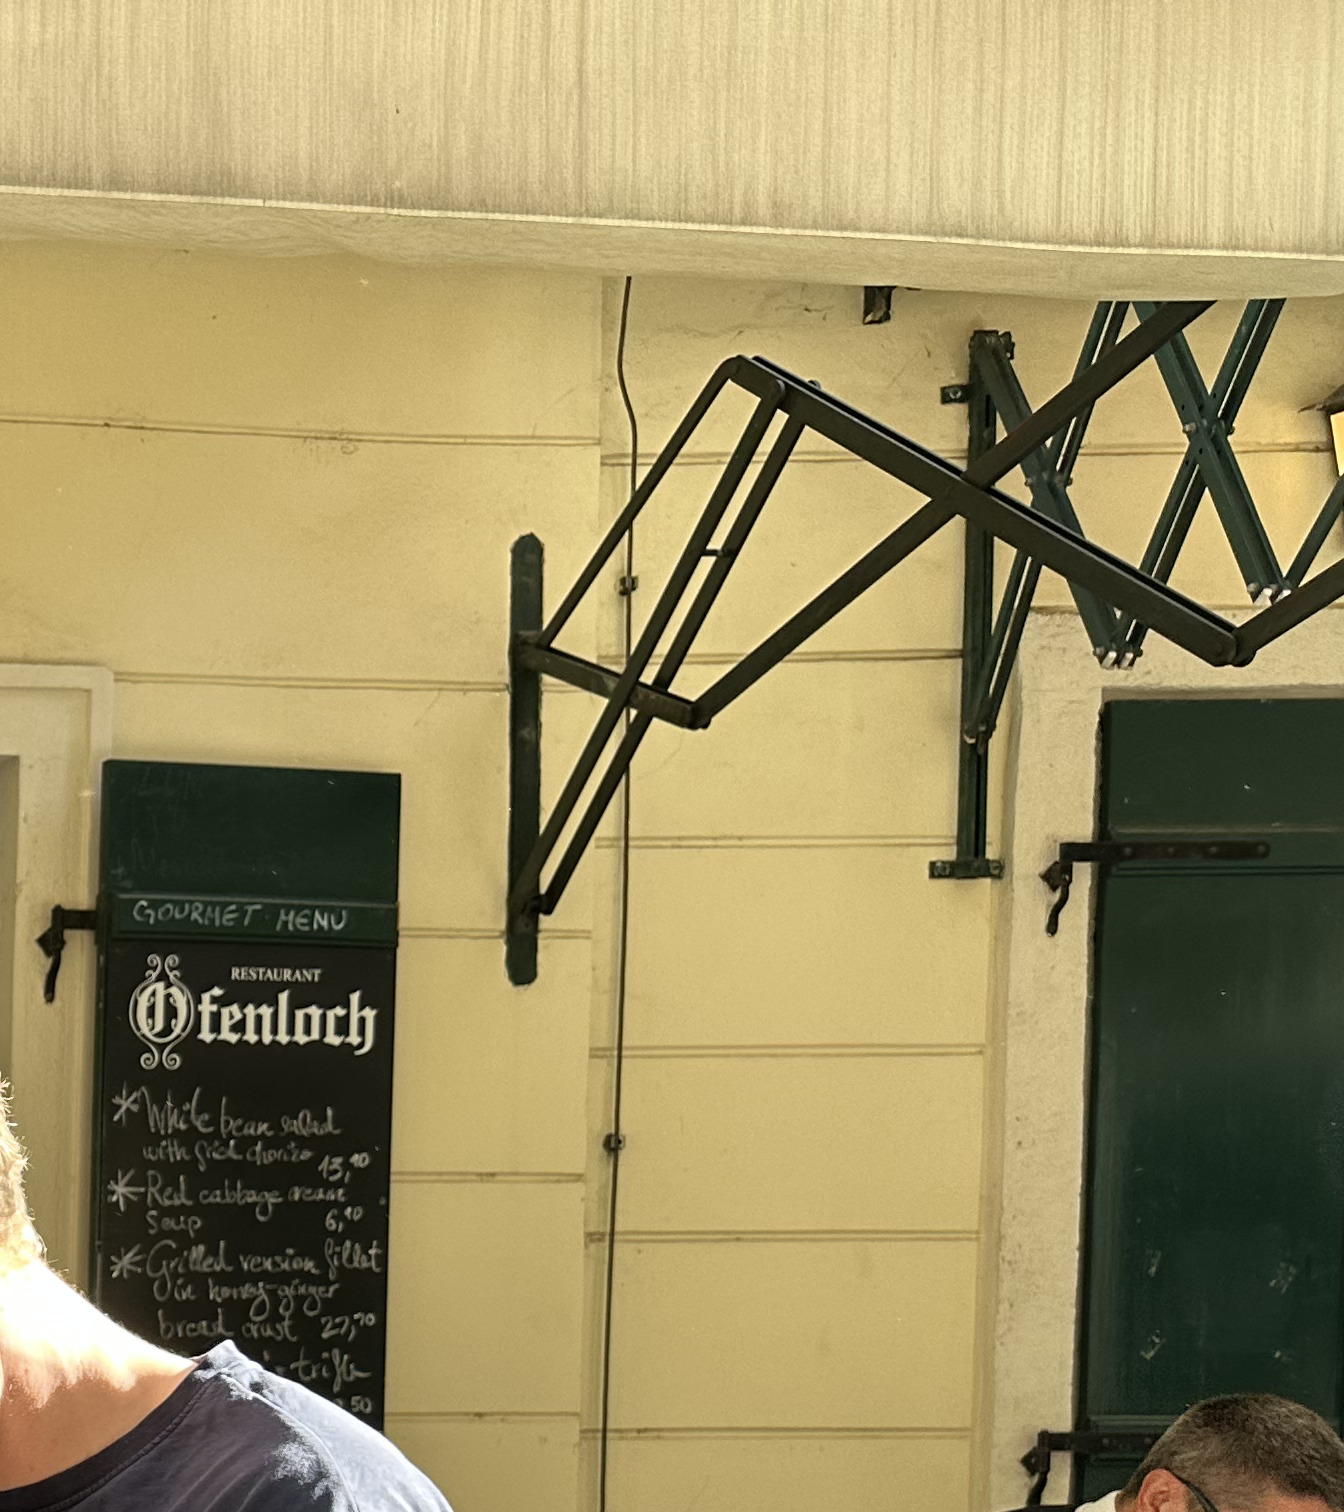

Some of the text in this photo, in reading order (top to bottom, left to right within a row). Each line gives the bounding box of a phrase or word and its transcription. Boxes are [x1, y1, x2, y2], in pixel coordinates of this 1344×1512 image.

[133, 900, 348, 931] GOURMET MENU
[230, 966, 322, 982] RESTAURANT
[129, 976, 378, 1058] Ofenloch
[137, 1086, 341, 1138] White bean salad
[143, 1140, 191, 1163] with
[146, 1170, 193, 1206] Red
[199, 1179, 283, 1222] cabbage
[146, 1239, 233, 1301] Grilled
[173, 1280, 196, 1301] in
[157, 1308, 235, 1340] bread
